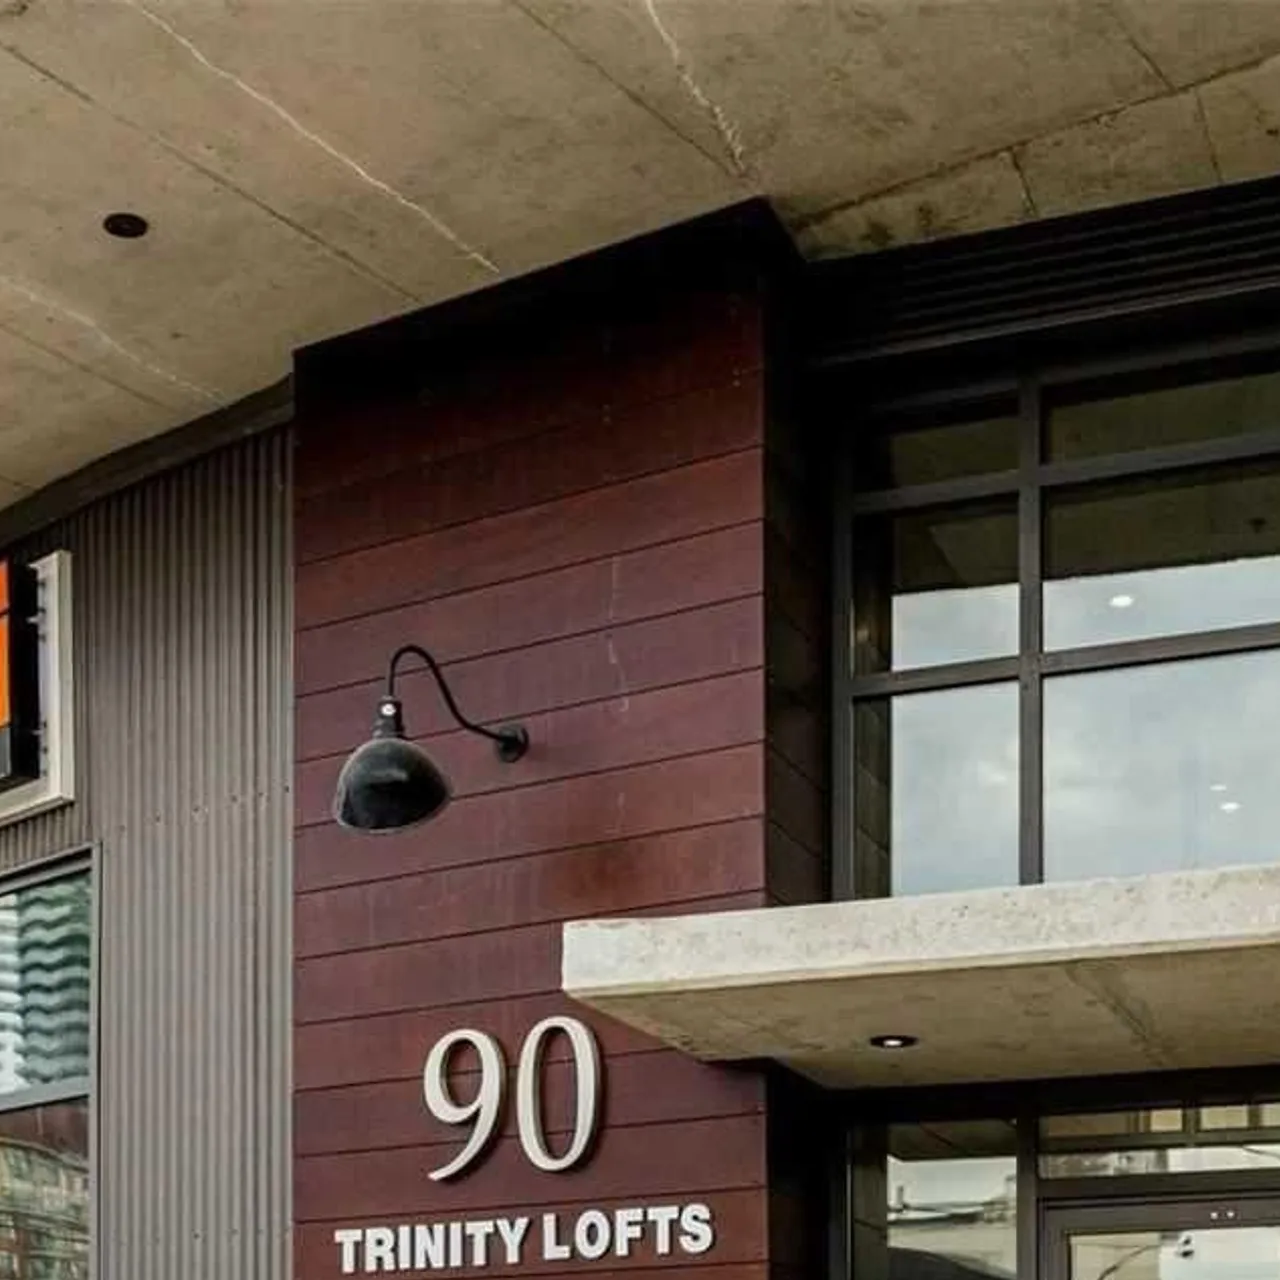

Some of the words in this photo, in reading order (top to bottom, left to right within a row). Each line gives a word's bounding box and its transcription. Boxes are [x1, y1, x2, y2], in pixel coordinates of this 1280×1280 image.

[423, 1015, 603, 1182] 90
[334, 1216, 530, 1274] TRINITY
[542, 1203, 714, 1262] LOFTS
